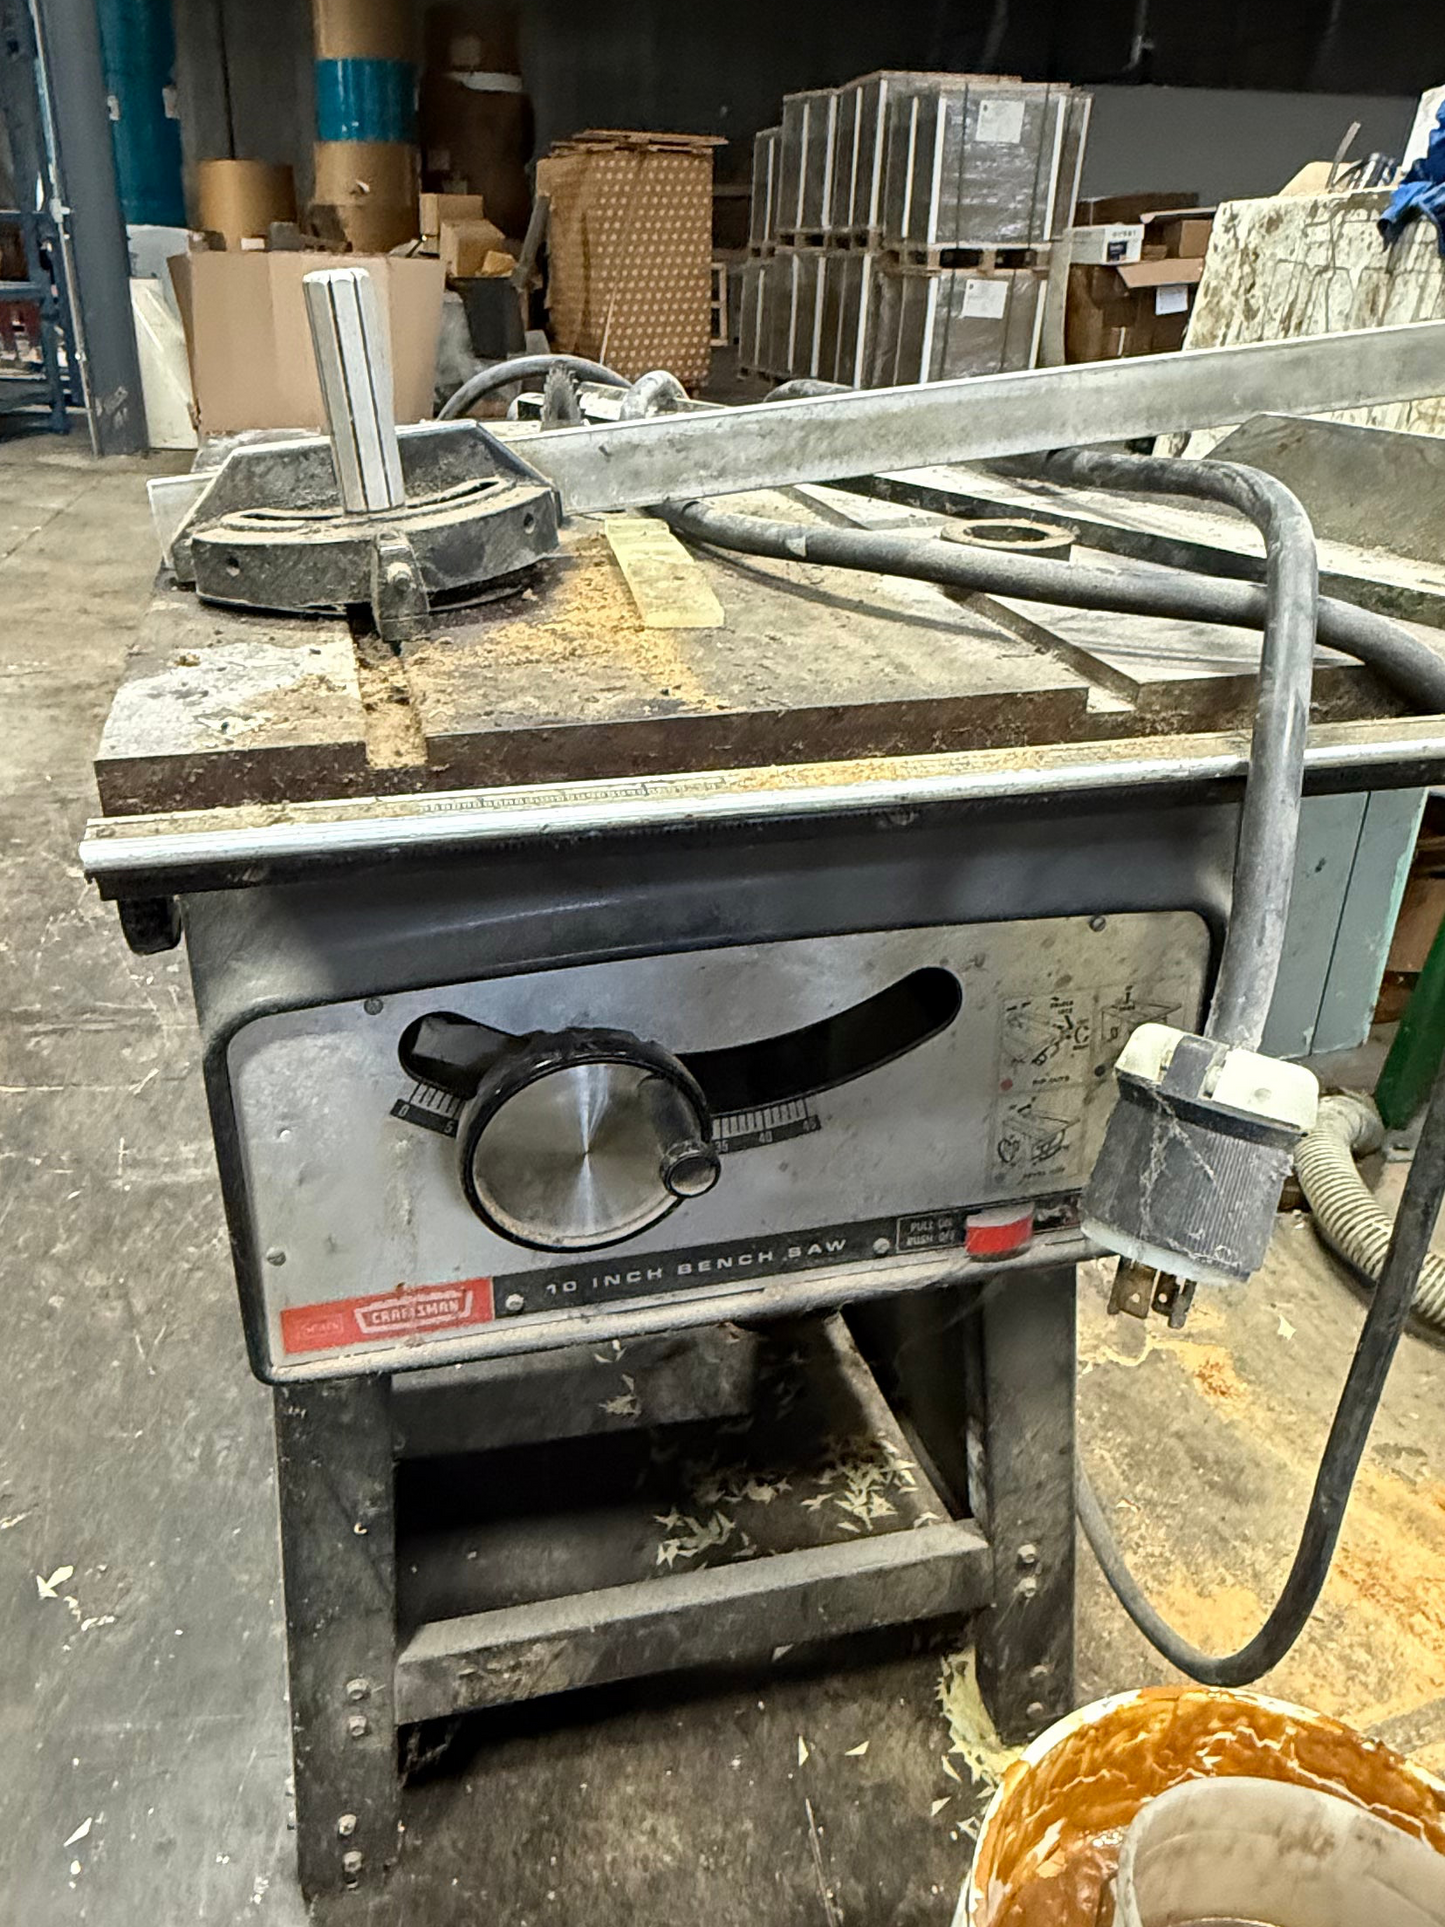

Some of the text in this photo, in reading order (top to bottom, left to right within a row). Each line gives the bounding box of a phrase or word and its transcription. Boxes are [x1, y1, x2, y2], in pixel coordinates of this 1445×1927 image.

[397, 1103, 455, 1133] 0 5
[759, 1129, 773, 1144] 40
[909, 1220, 934, 1233] PULL
[545, 1239, 847, 1296] 10 INCH BENCH SAW
